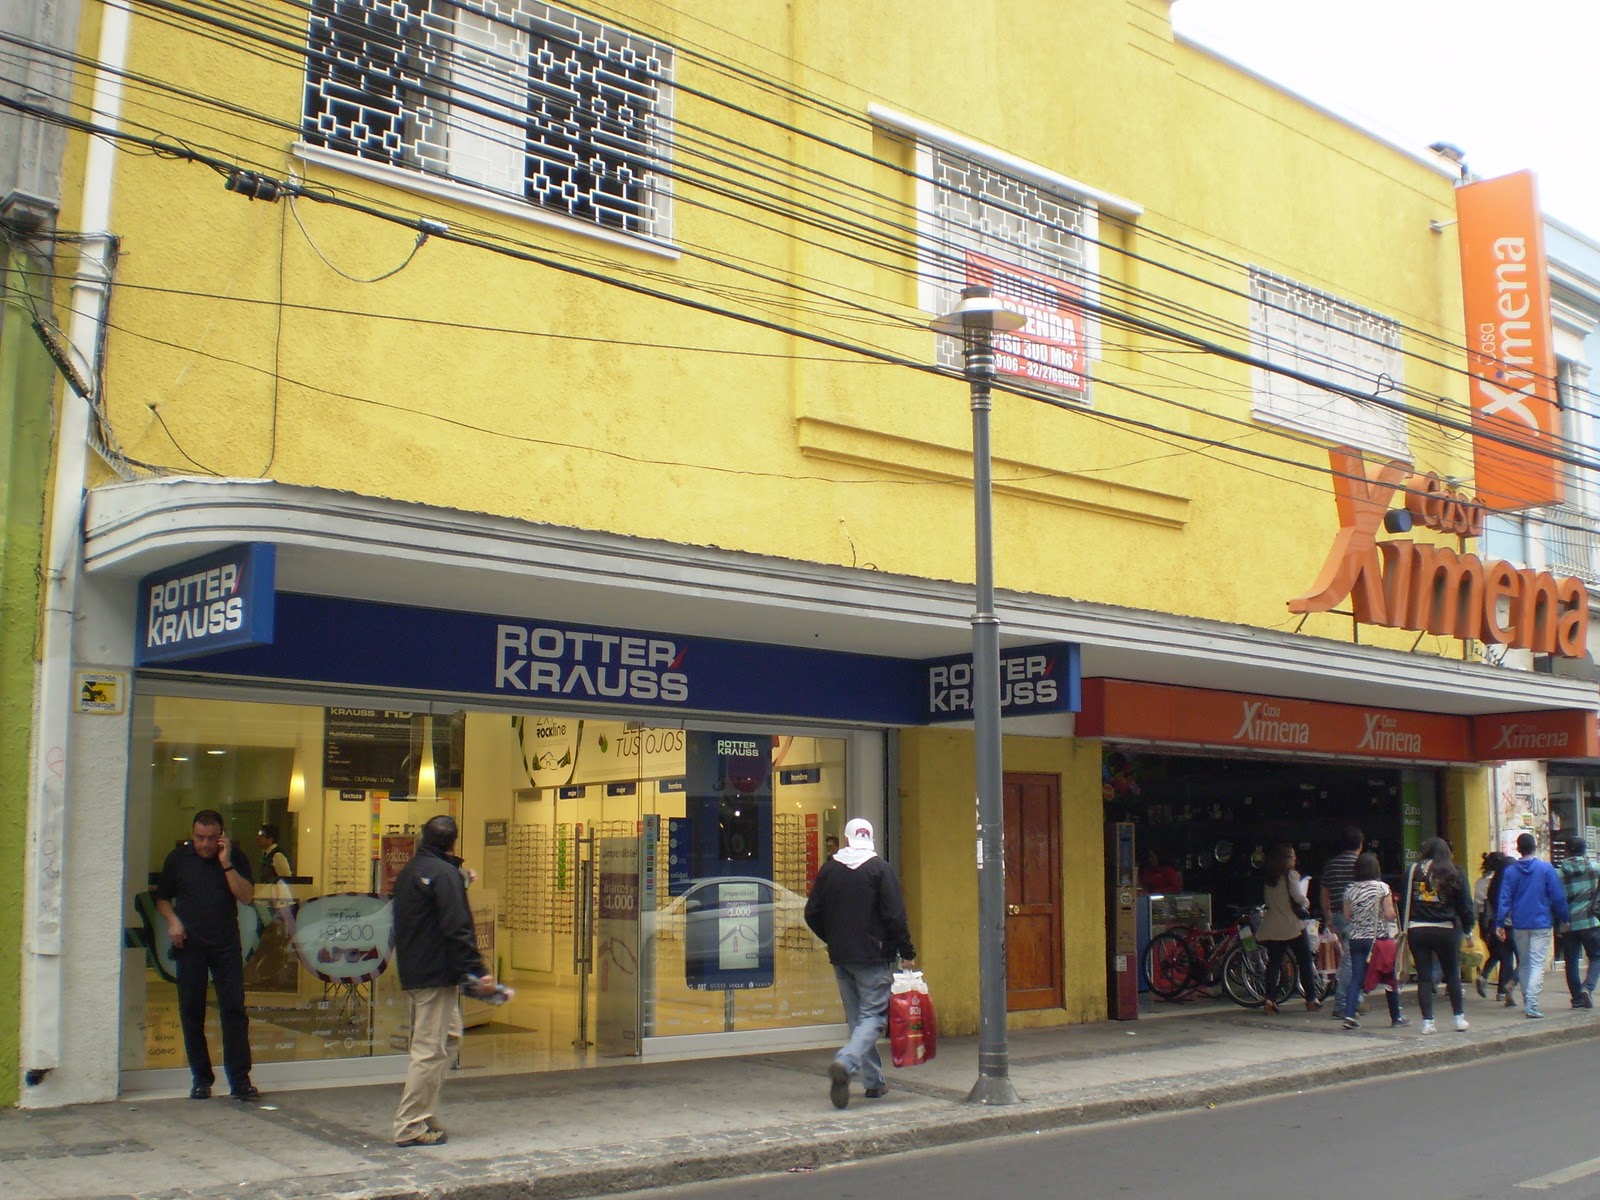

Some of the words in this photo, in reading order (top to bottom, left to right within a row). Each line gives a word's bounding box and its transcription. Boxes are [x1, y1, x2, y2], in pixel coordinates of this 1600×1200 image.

[1023, 339, 1048, 363] 300
[1477, 237, 1540, 437] Ximena
[1478, 323, 1496, 366] Casa
[1404, 471, 1486, 537] Casa
[1288, 445, 1588, 659] Ximena
[150, 563, 238, 613] ROTTER
[147, 597, 243, 648] KRAUSS
[496, 624, 677, 669] ROTTER
[495, 659, 689, 702] KRAUSS
[929, 655, 1047, 689] ROER
[330, 707, 375, 717] KRAUSS
[929, 679, 1058, 713] KRUSS
[1263, 703, 1281, 717] Casa
[1232, 700, 1310, 744] Ximena
[1356, 712, 1422, 753] Ximena
[1491, 724, 1569, 750] Ximena
[616, 737, 641, 758] TUS
[645, 730, 684, 755] OJOS
[717, 739, 756, 749] ROTTER
[717, 747, 759, 757] KRAUSS
[342, 790, 362, 799] lectura
